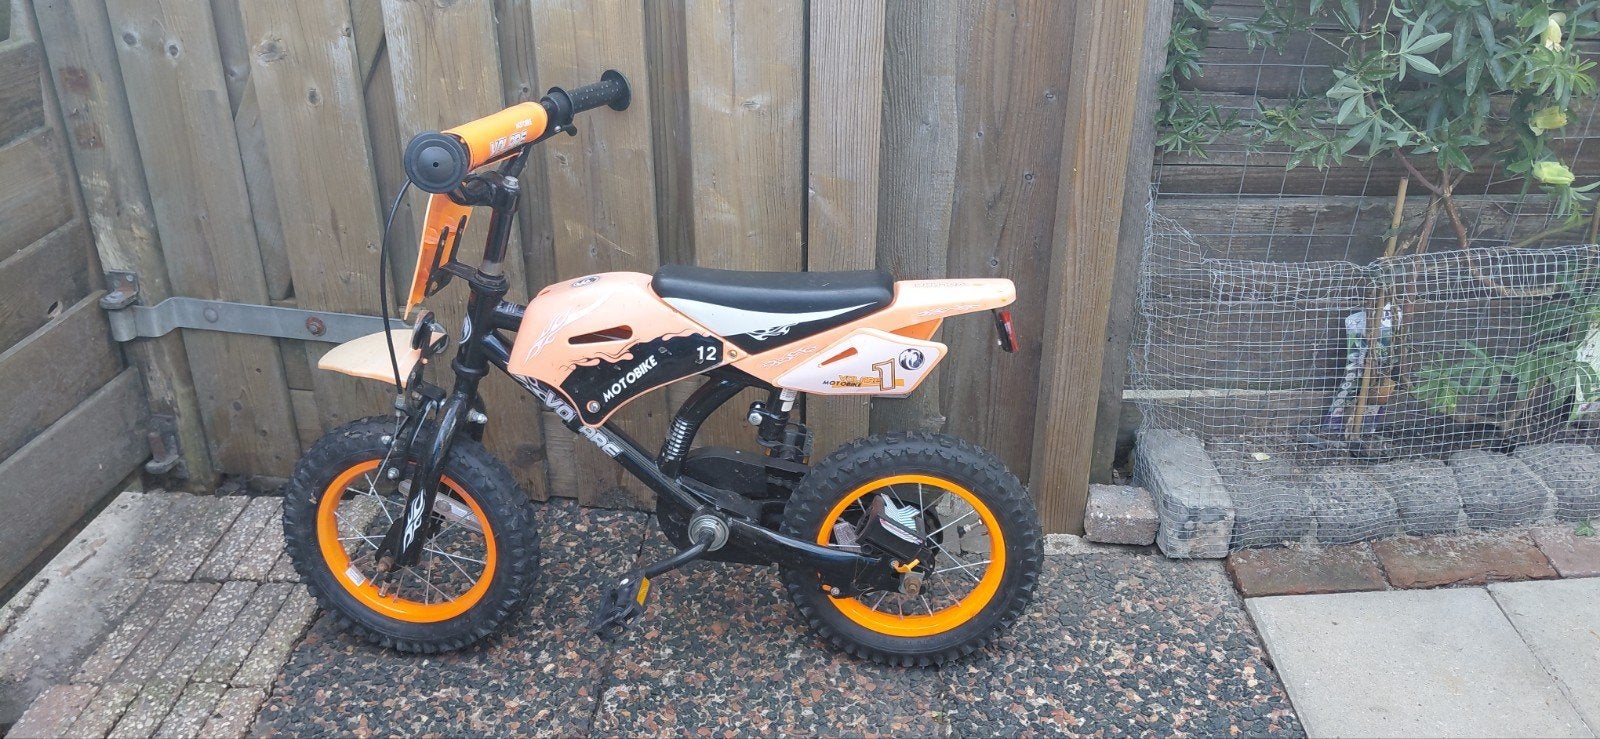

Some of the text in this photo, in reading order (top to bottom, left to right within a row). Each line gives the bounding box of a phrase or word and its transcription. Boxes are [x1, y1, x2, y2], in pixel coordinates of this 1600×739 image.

[696, 345, 717, 361] 12
[602, 354, 658, 403] MOTOBIKE
[871, 358, 895, 391] 1
